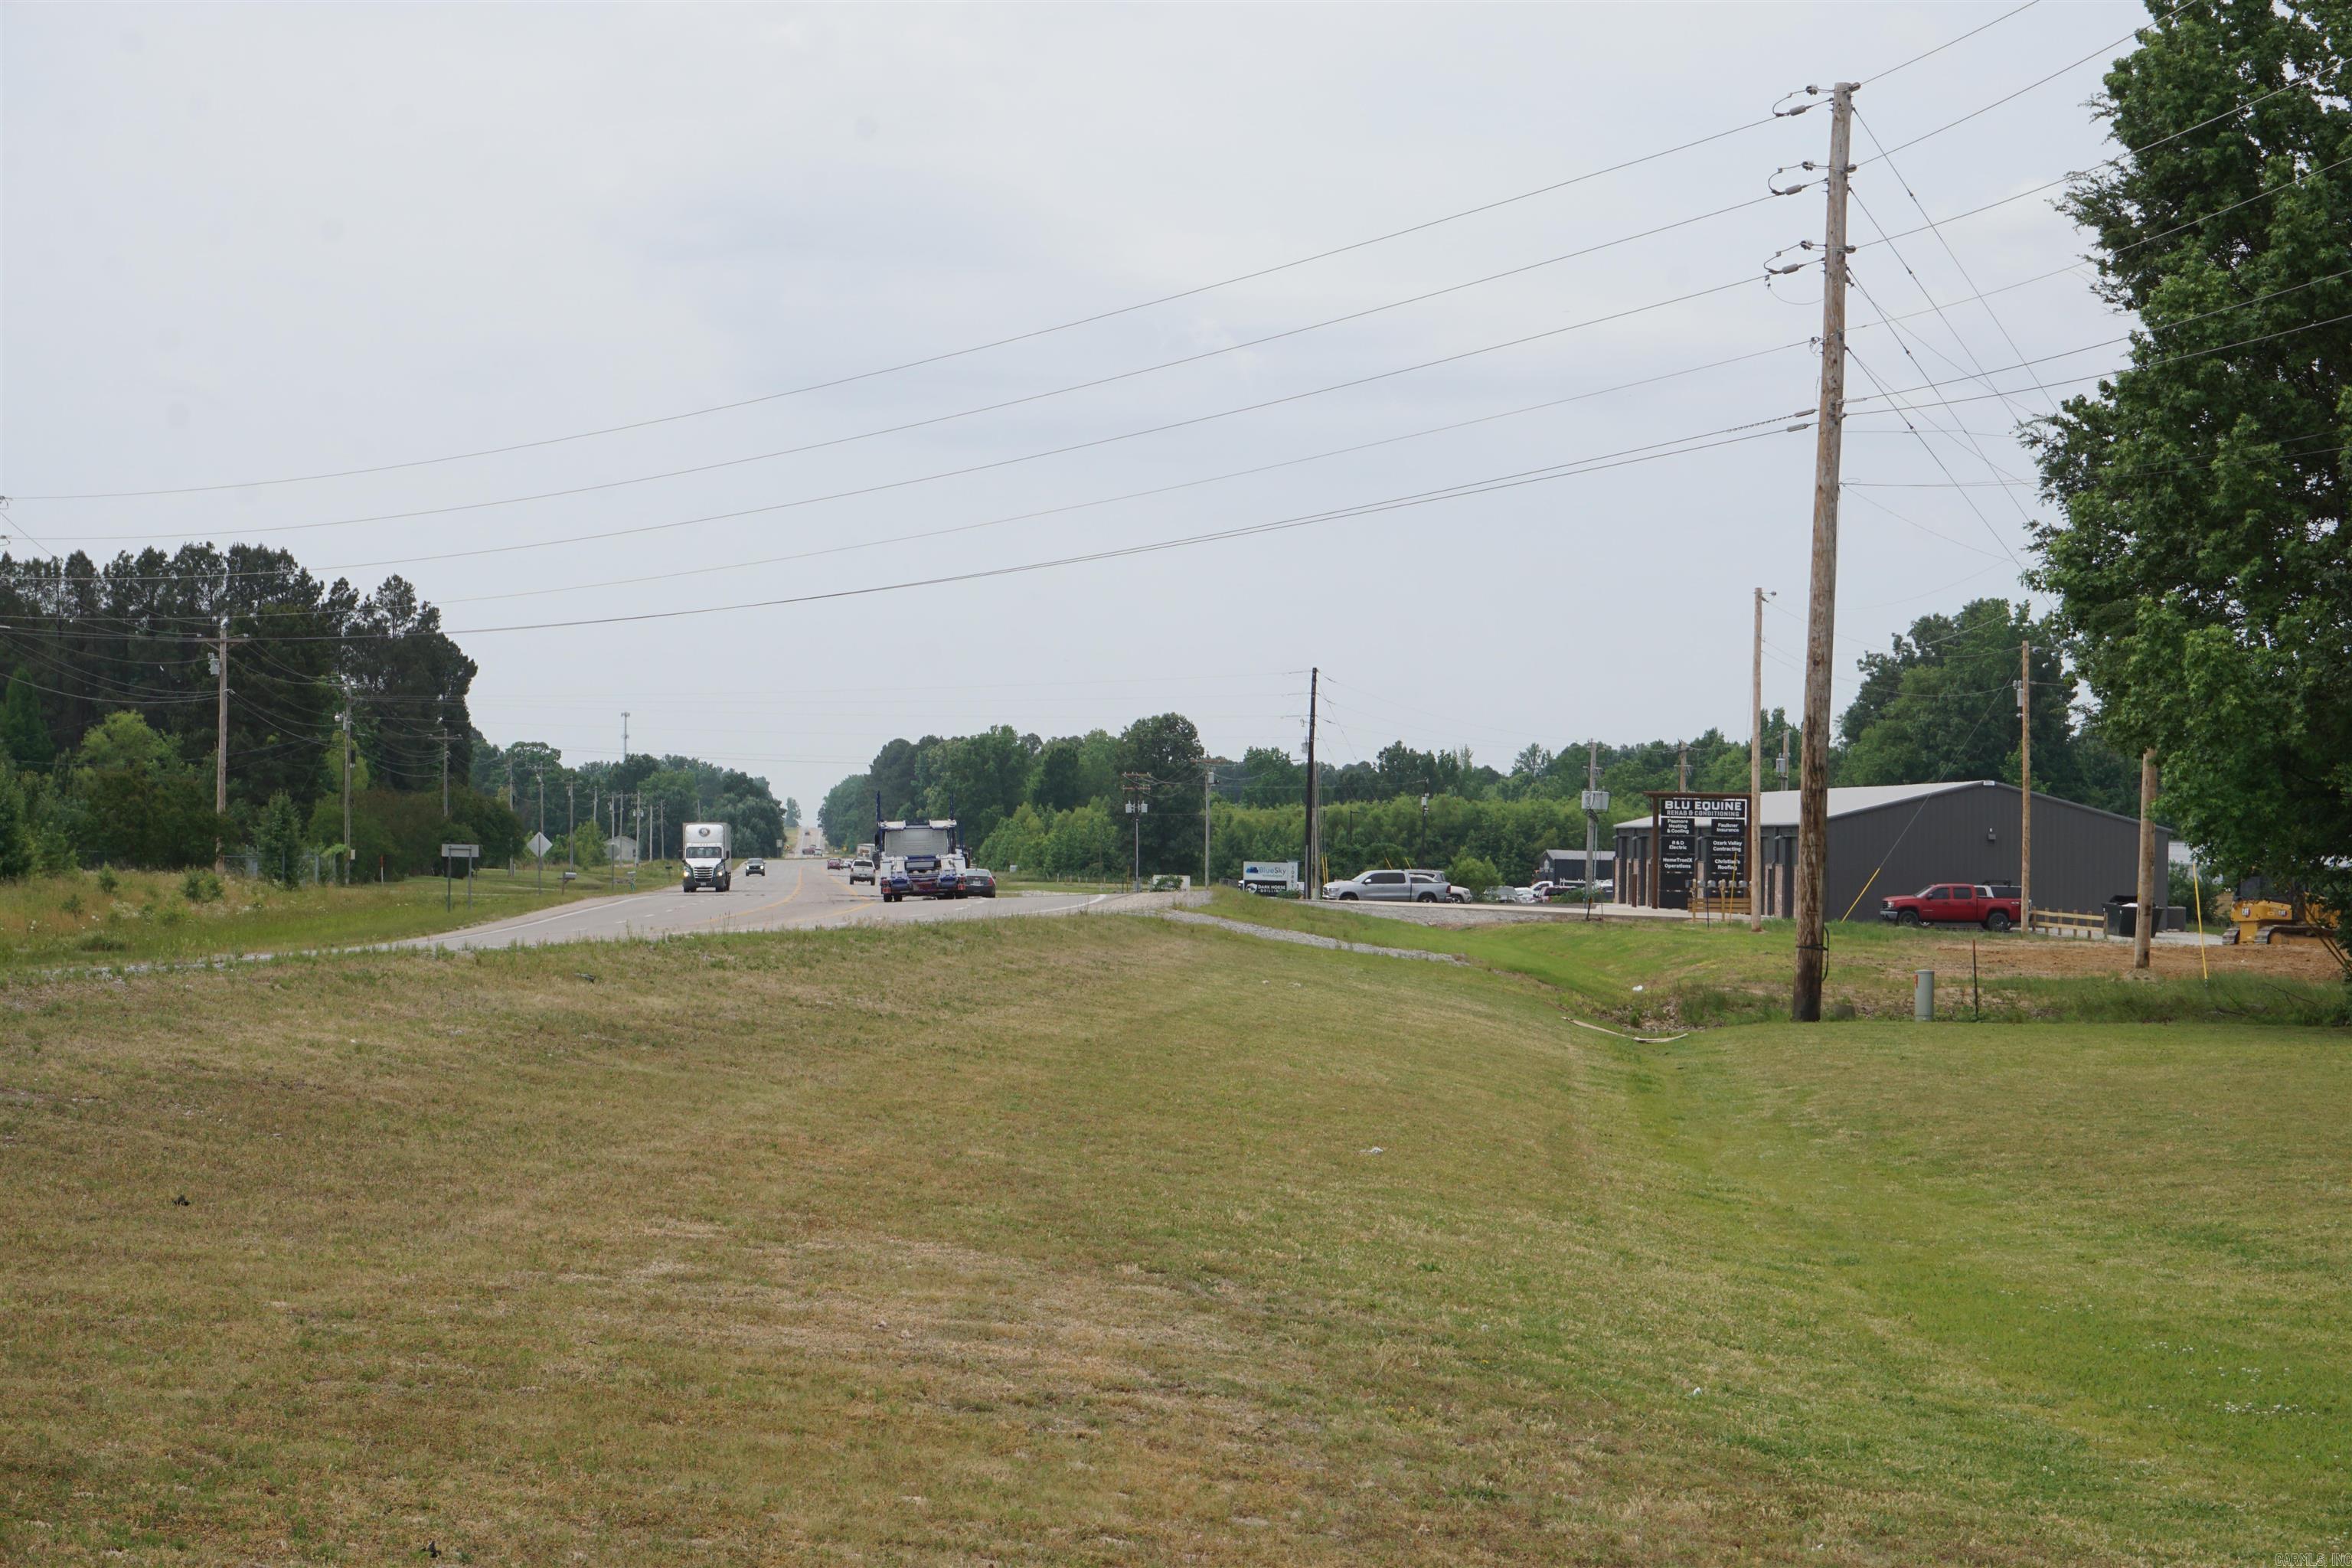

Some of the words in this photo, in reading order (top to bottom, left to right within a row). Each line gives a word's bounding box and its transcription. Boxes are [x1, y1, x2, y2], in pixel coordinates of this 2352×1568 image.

[1664, 800, 1690, 810] BLU
[1694, 801, 1742, 812] EQUINE
[1259, 866, 1286, 876] BlueSky
